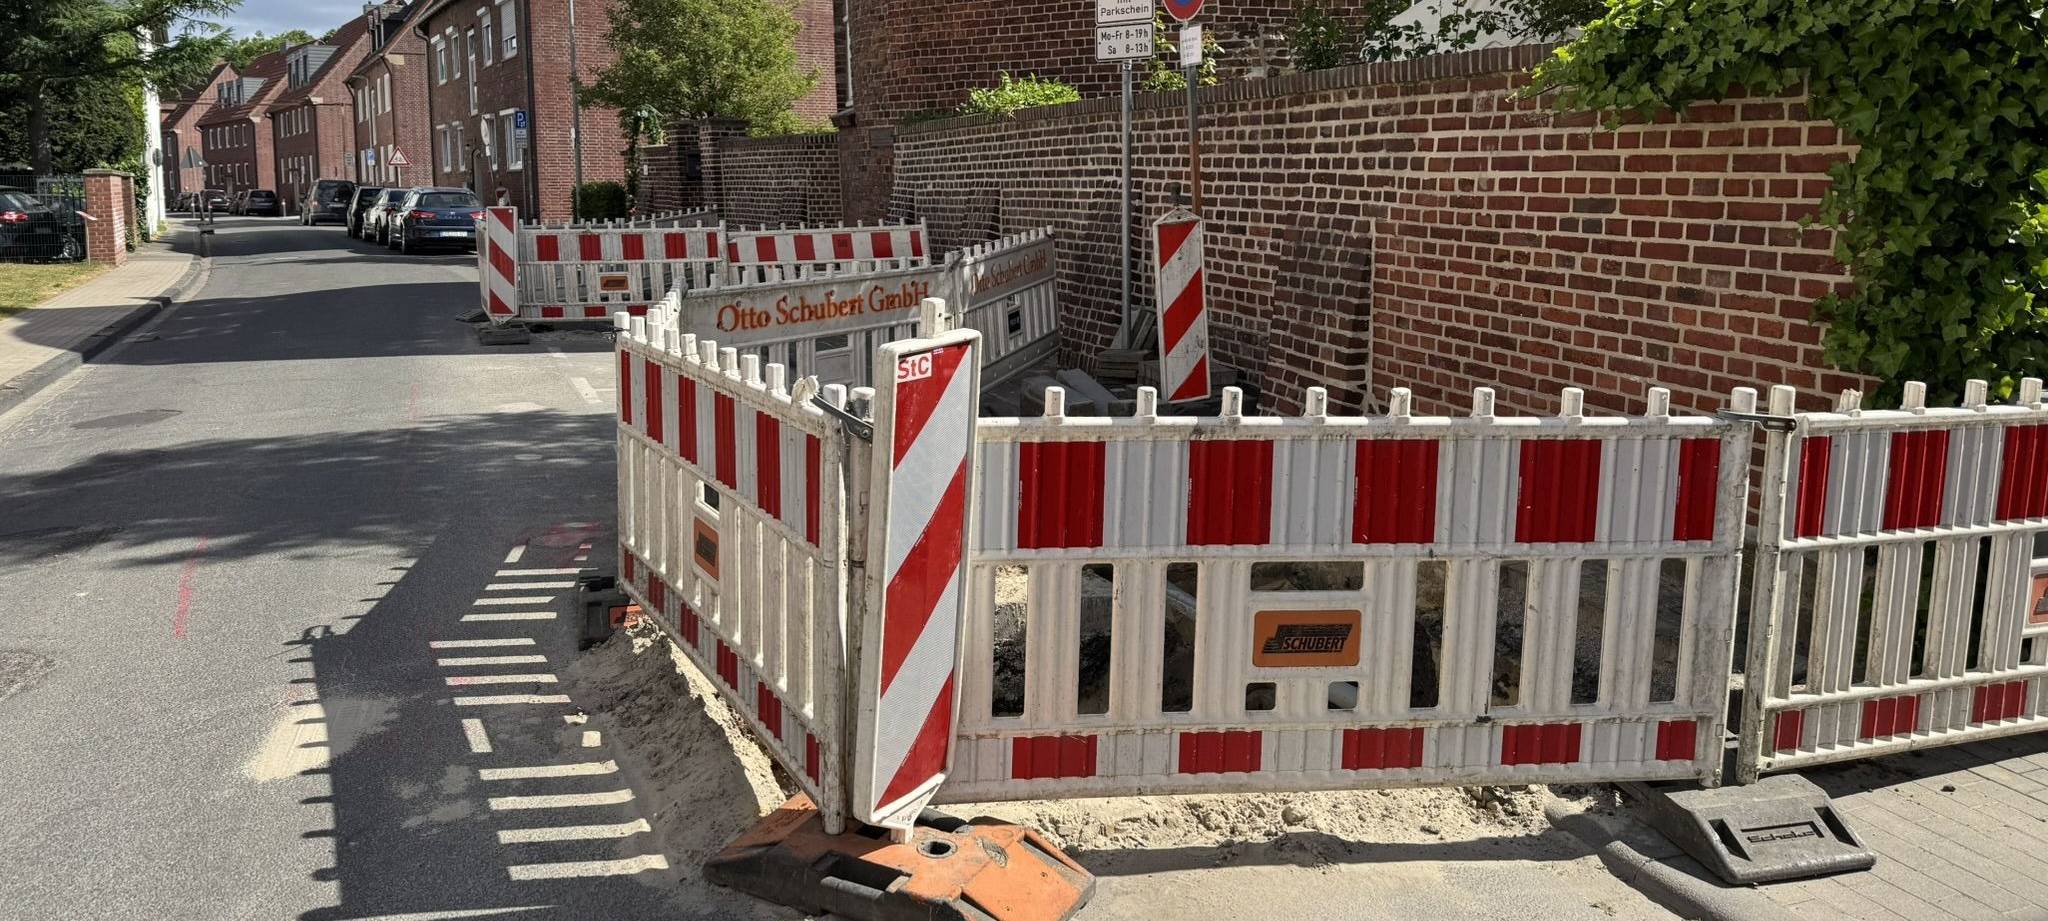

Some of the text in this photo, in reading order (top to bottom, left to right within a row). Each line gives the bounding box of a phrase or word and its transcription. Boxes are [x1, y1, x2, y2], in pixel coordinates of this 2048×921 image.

[1100, 4, 1149, 16] Parkschein
[1101, 30, 1122, 41] Mo-Fr
[1107, 45, 1117, 55] Sa
[971, 249, 1046, 297] Otto Schubert GmbH
[717, 280, 930, 333] Otto Schubert GmbH
[897, 355, 930, 380] StC
[1282, 636, 1347, 650] SCHUBERT
